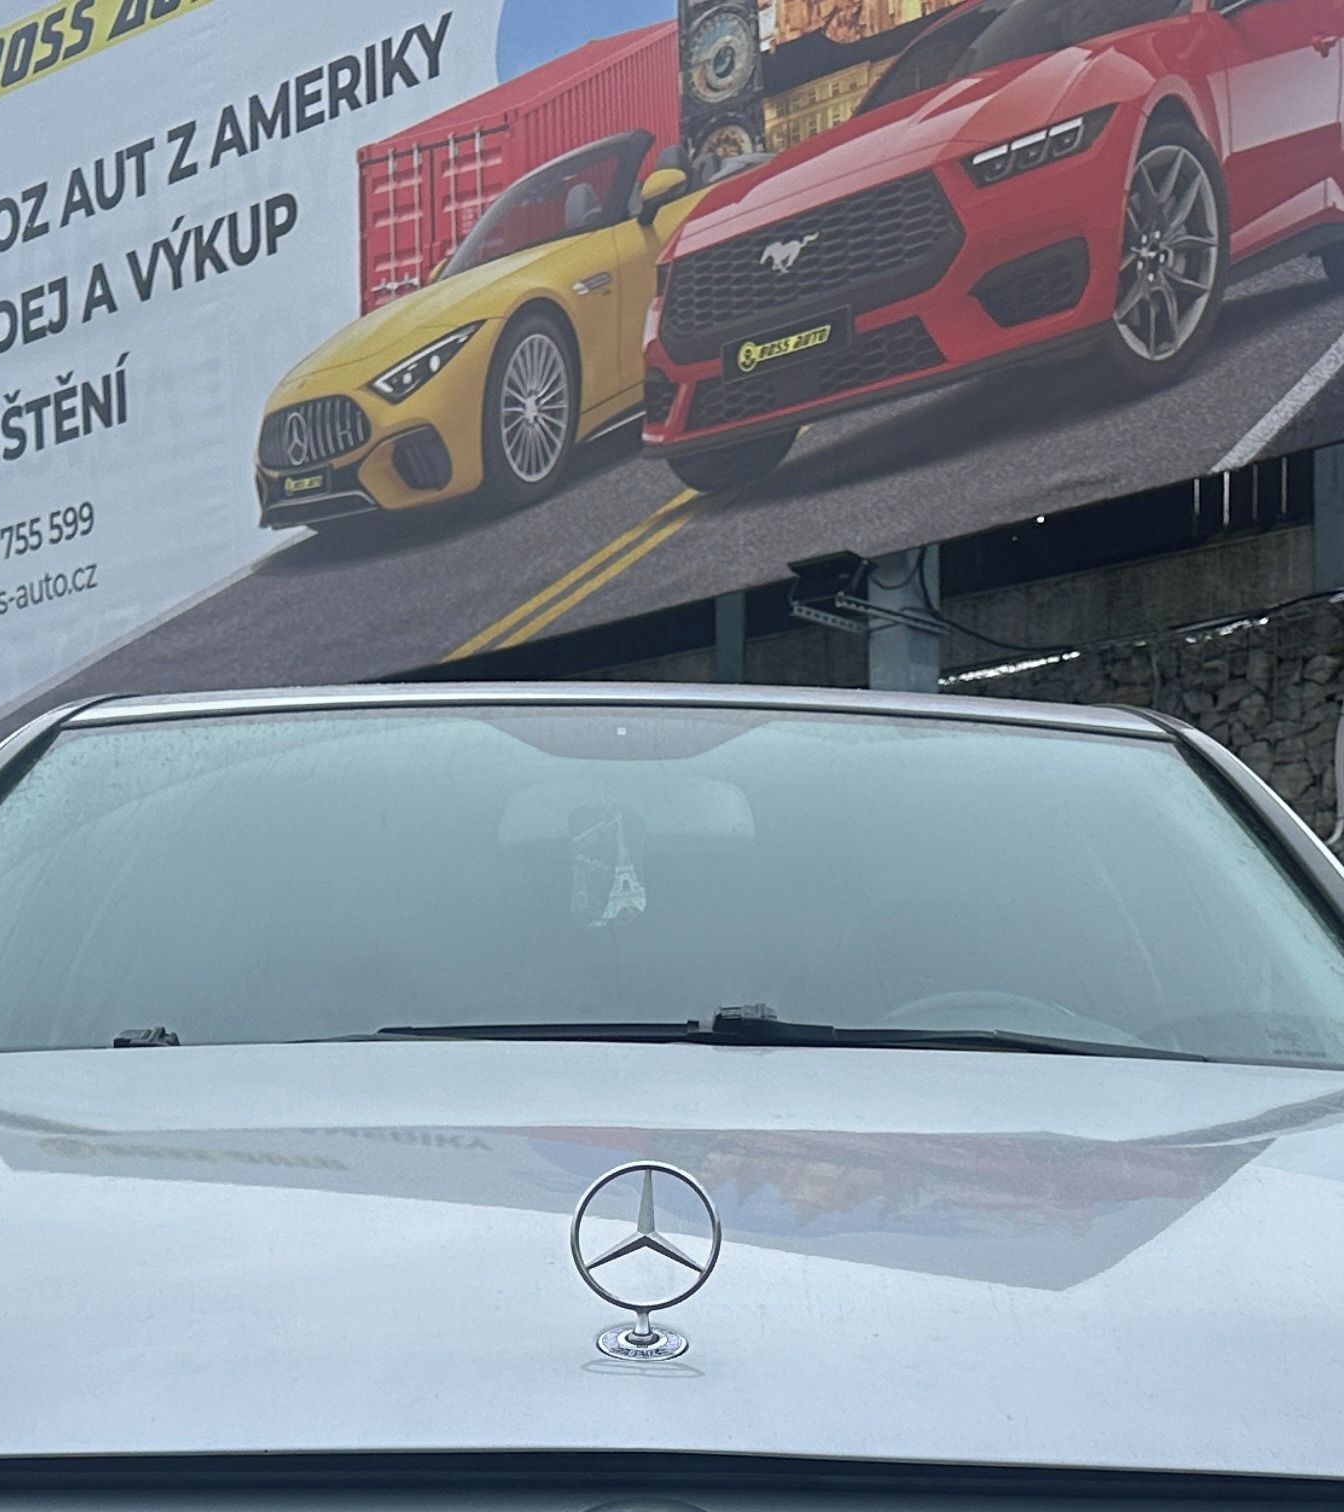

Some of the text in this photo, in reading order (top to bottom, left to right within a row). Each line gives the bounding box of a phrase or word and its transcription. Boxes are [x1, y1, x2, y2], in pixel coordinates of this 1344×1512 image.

[60, 137, 155, 229] AUT
[167, 120, 199, 185] Z
[209, 11, 453, 169] AMERIKY
[81, 263, 118, 323] A
[126, 193, 298, 302] VÝKUP
[0, 517, 42, 560] 755
[48, 501, 95, 545] 599
